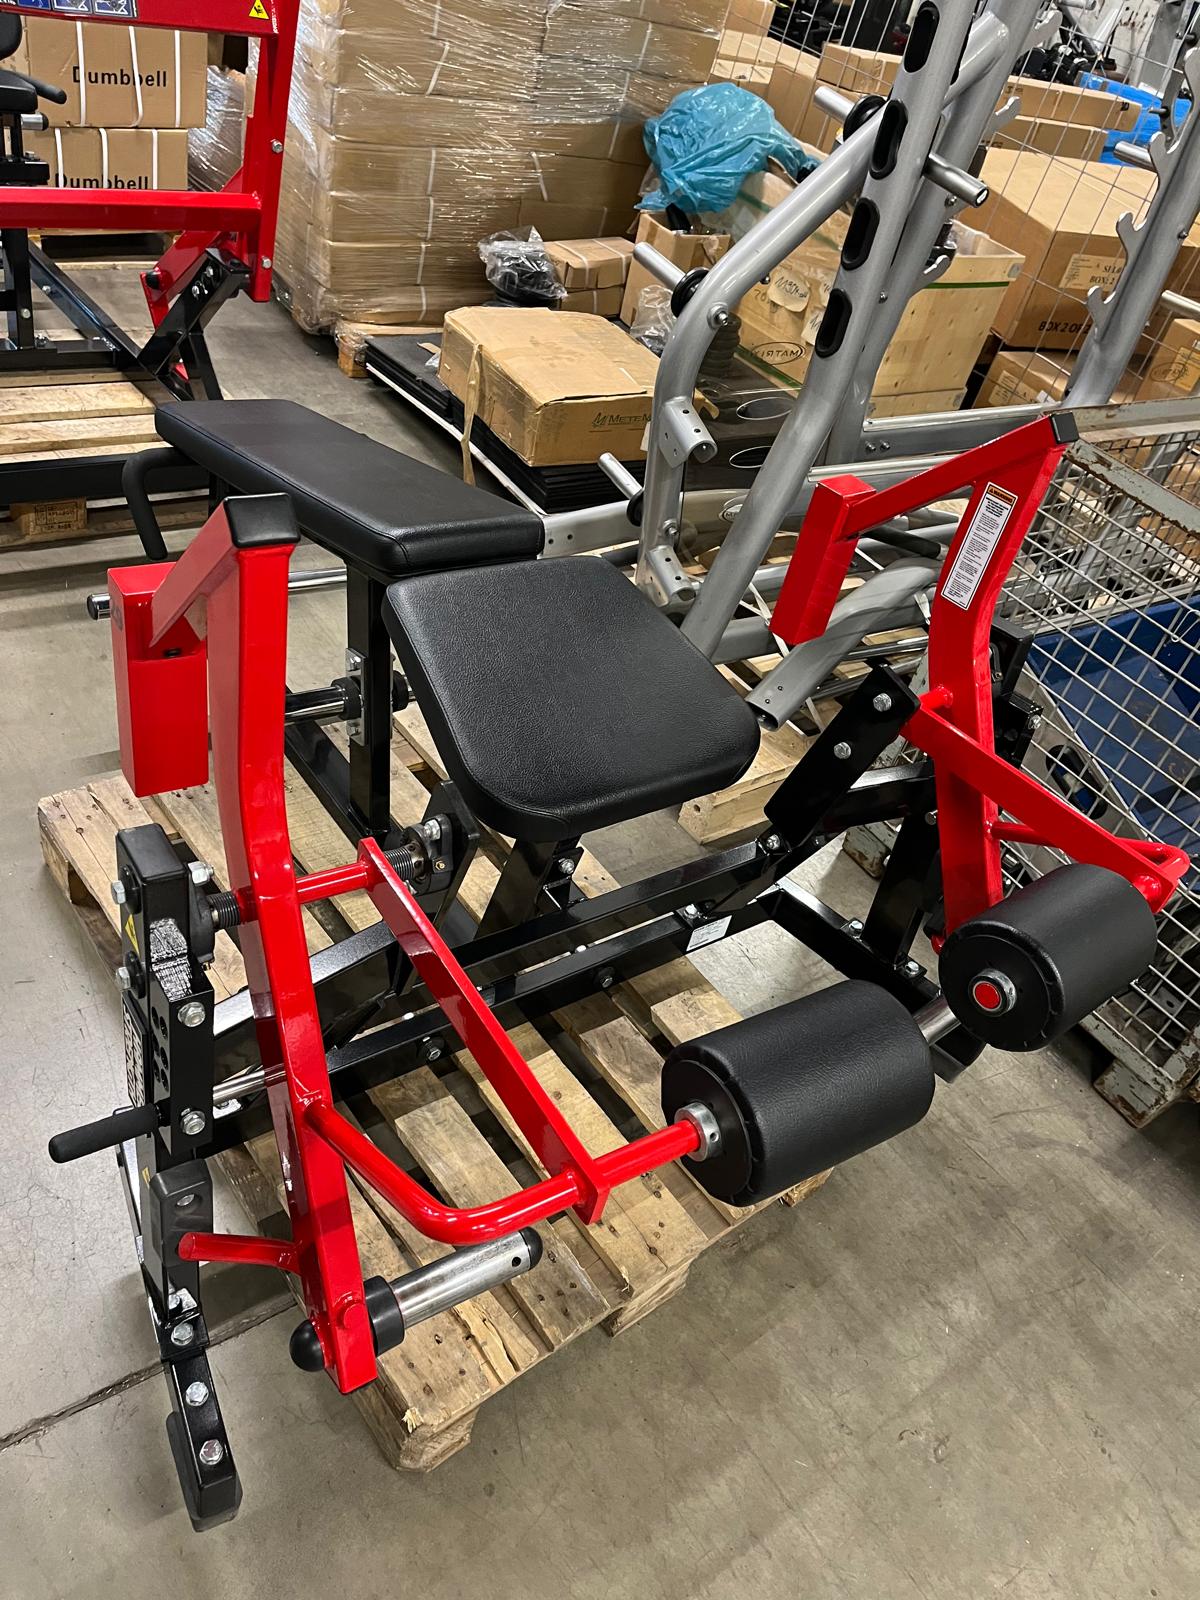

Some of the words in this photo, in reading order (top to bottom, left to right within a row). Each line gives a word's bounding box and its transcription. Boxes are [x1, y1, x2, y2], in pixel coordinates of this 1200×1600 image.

[72, 66, 167, 87] Dumbbell
[54, 173, 149, 190] Dumbbell
[1038, 321, 1060, 332] BOX
[1060, 322, 1069, 332] 2
[129, 1021, 146, 1108] HAMME
